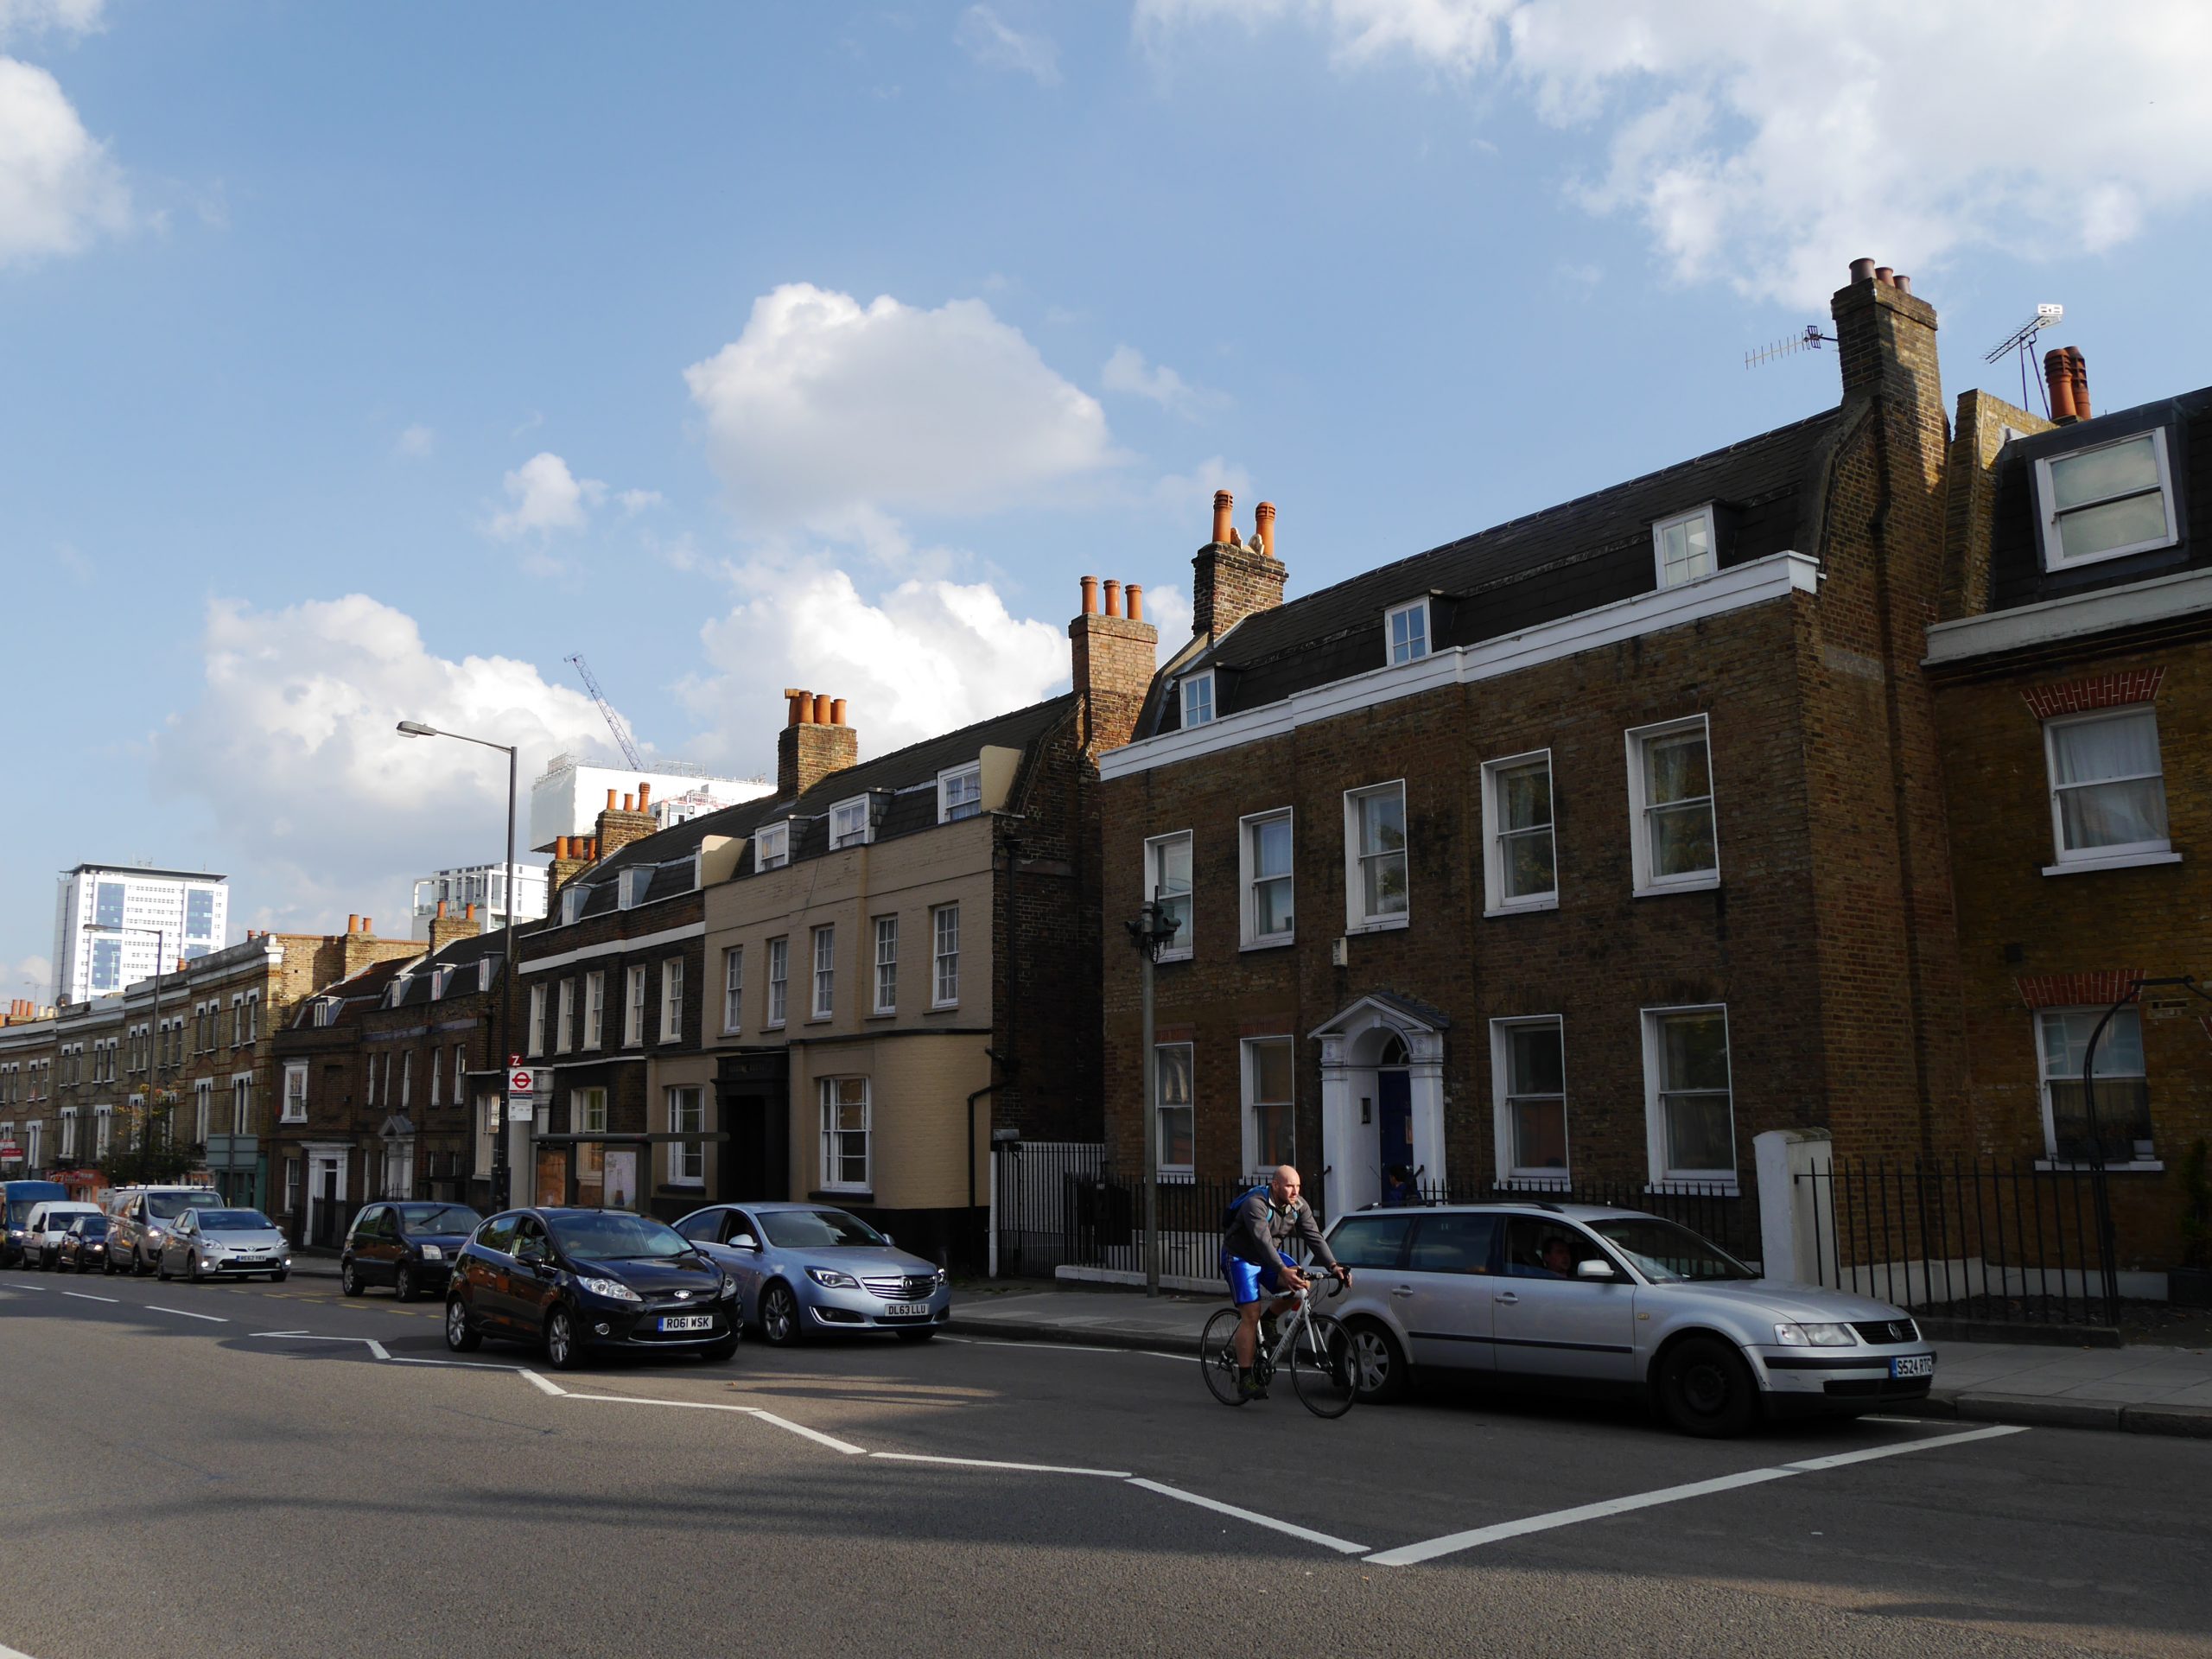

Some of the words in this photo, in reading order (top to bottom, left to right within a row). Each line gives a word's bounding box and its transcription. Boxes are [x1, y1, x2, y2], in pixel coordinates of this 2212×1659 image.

[512, 1055, 520, 1066] Z
[888, 1306, 910, 1315] DL63
[912, 1305, 925, 1314] LLU
[666, 1318, 688, 1329] RO61
[691, 1317, 709, 1327] WSK
[1897, 1358, 1918, 1375] S524
